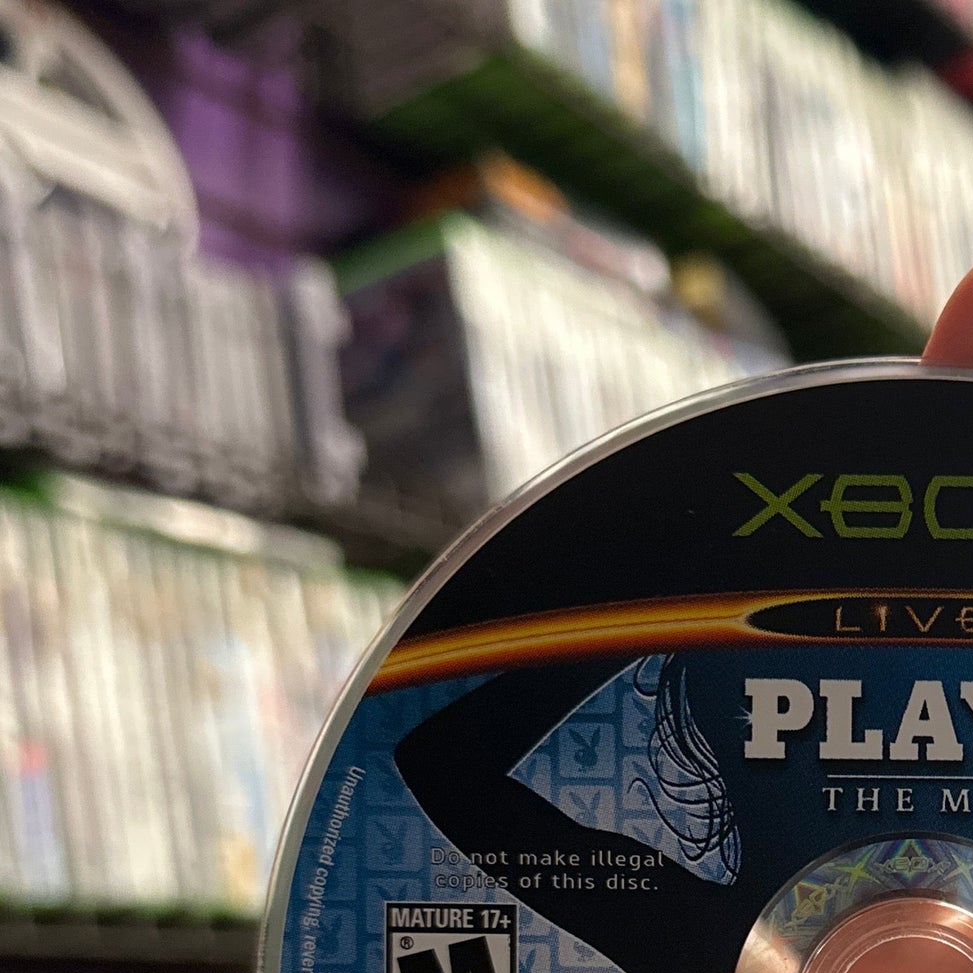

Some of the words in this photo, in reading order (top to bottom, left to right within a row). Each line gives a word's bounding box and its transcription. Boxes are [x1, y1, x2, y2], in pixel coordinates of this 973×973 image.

[822, 787, 914, 813] THE
[318, 764, 366, 866] Unauthorized
[430, 848, 460, 864] Do
[475, 849, 509, 865] not
[519, 849, 582, 866] make
[591, 850, 664, 871] illegal
[435, 873, 509, 891] copies
[519, 872, 542, 889] of
[552, 873, 595, 890] this
[606, 874, 659, 891] disc.
[302, 867, 327, 930] copying,
[391, 908, 474, 928] MATURE
[481, 909, 512, 929] 17+
